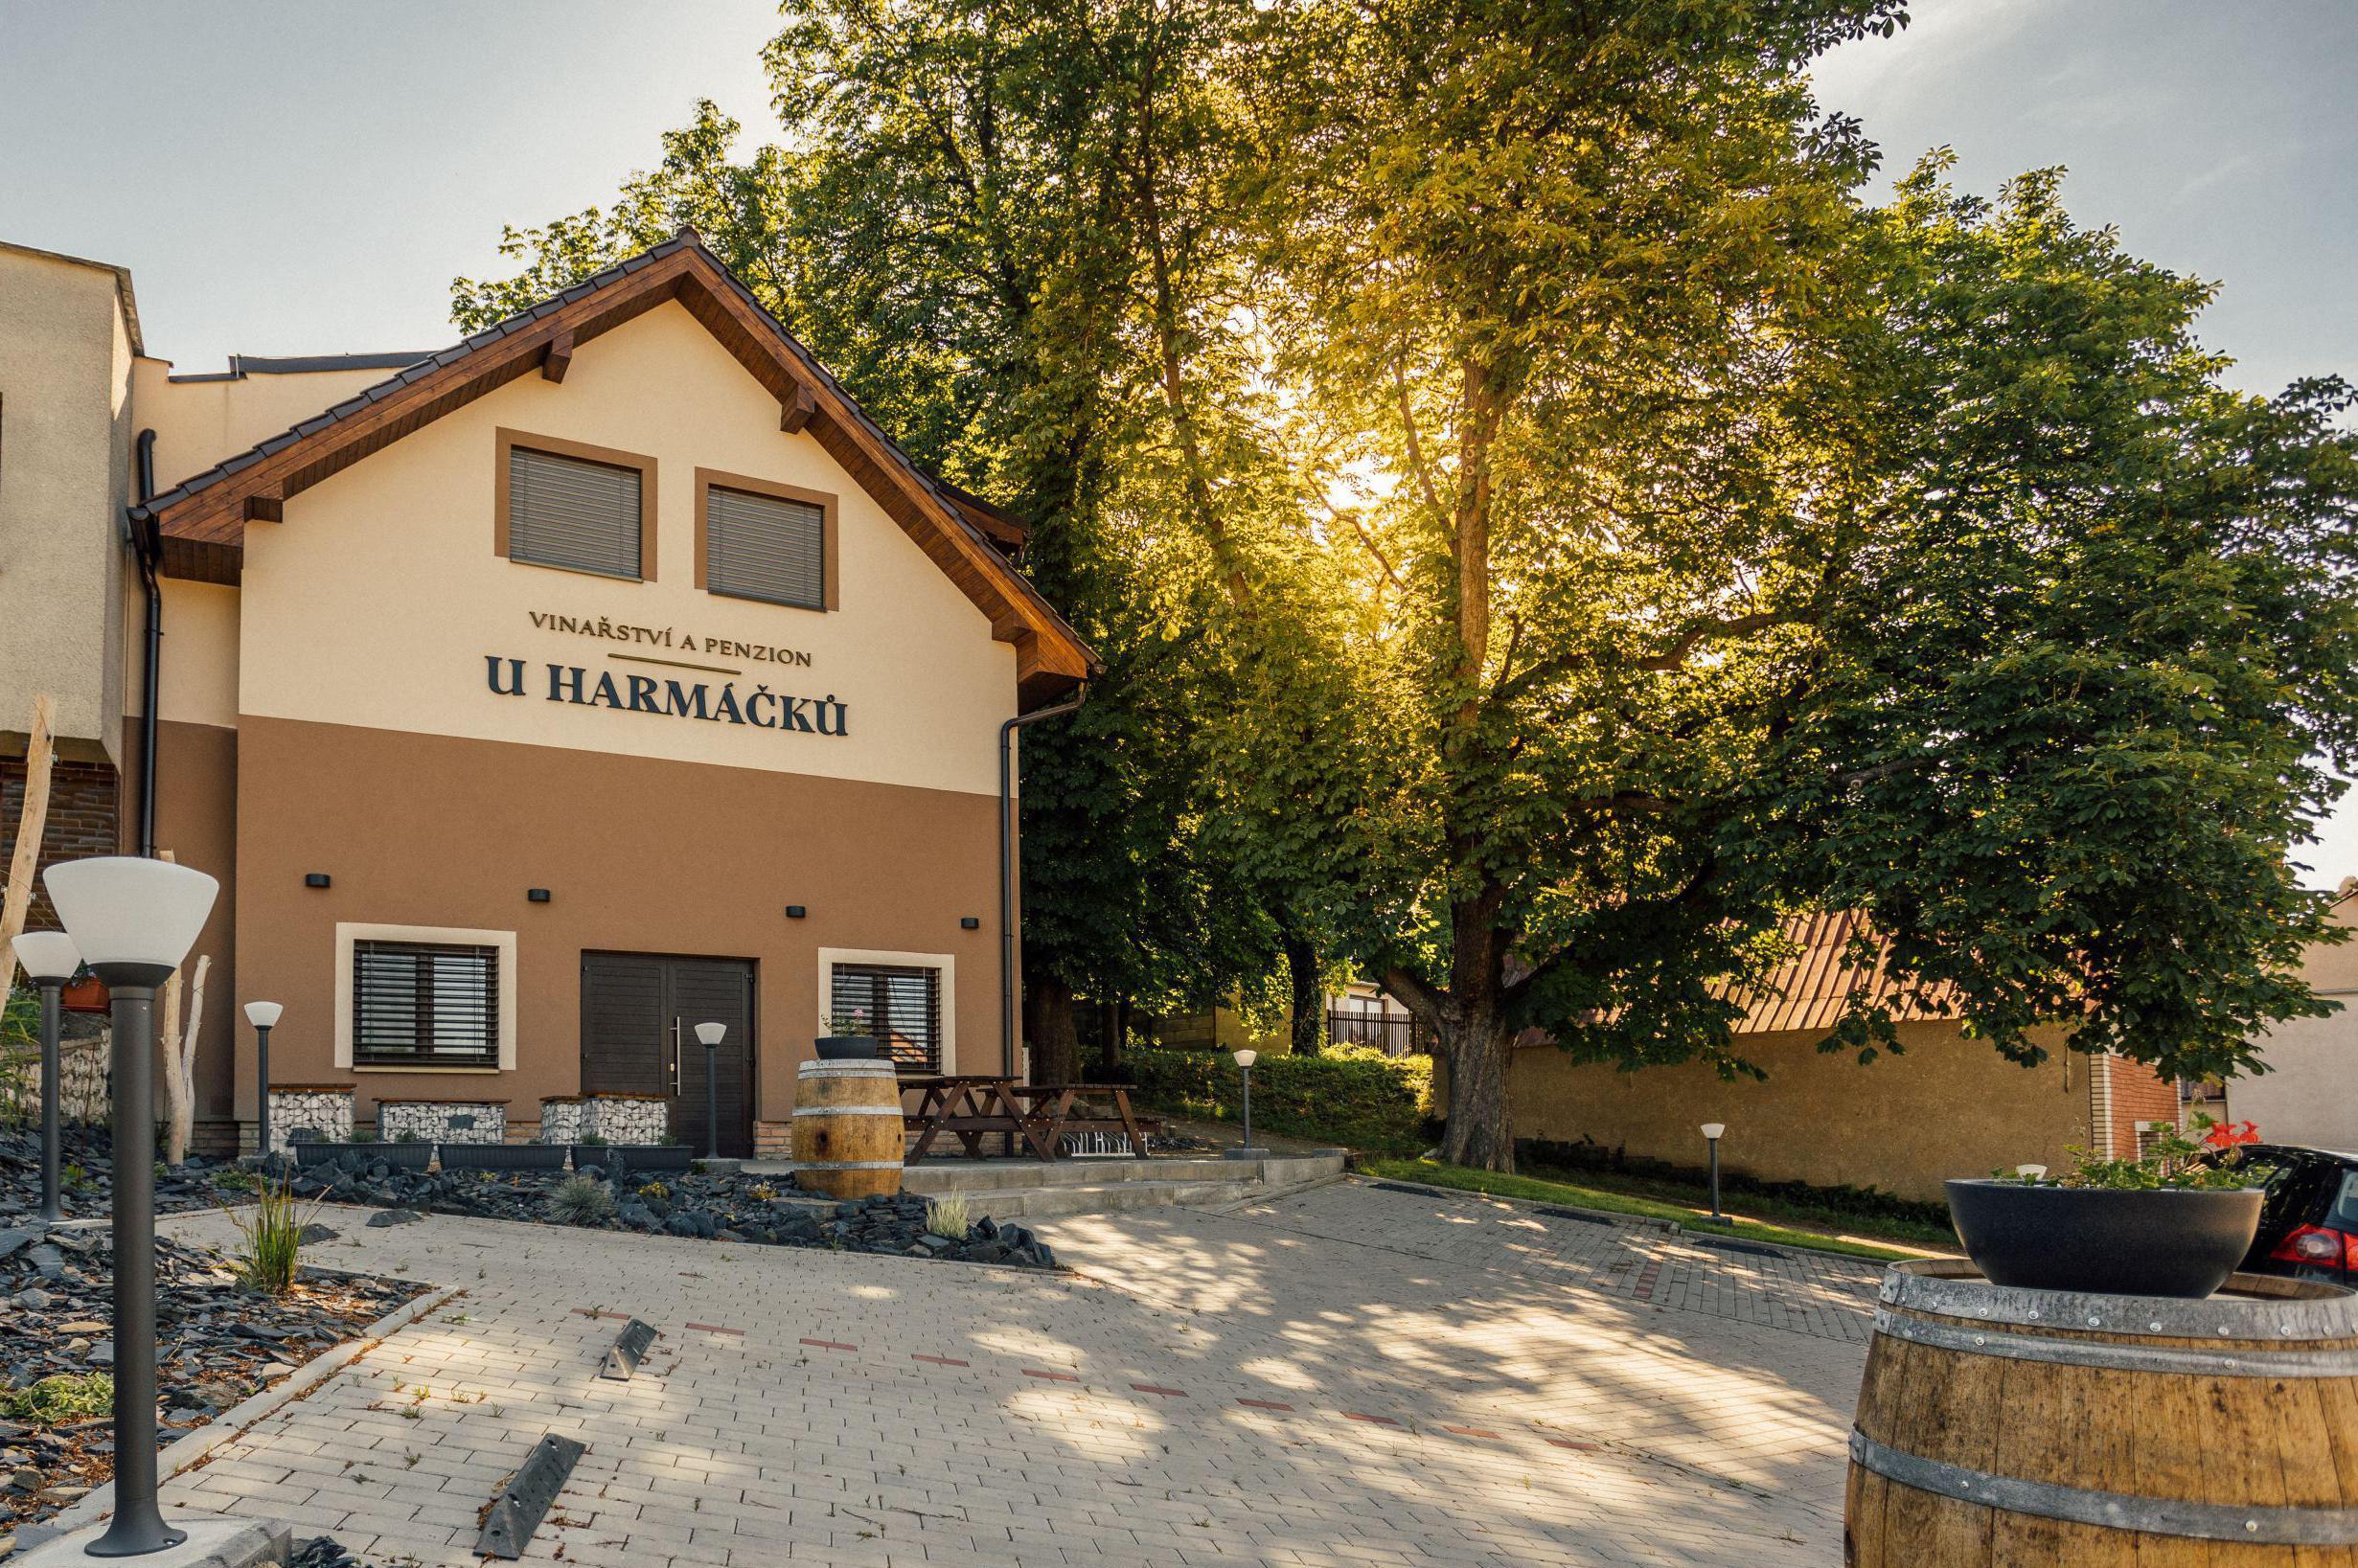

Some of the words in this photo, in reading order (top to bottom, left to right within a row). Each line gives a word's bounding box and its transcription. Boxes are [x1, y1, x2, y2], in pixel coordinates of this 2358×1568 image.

[528, 610, 673, 648] VINAŘSTVÍ
[679, 634, 697, 651] A
[704, 637, 813, 668] PENZION
[484, 655, 527, 696] U
[545, 663, 849, 737] HARMÁČKŮ
